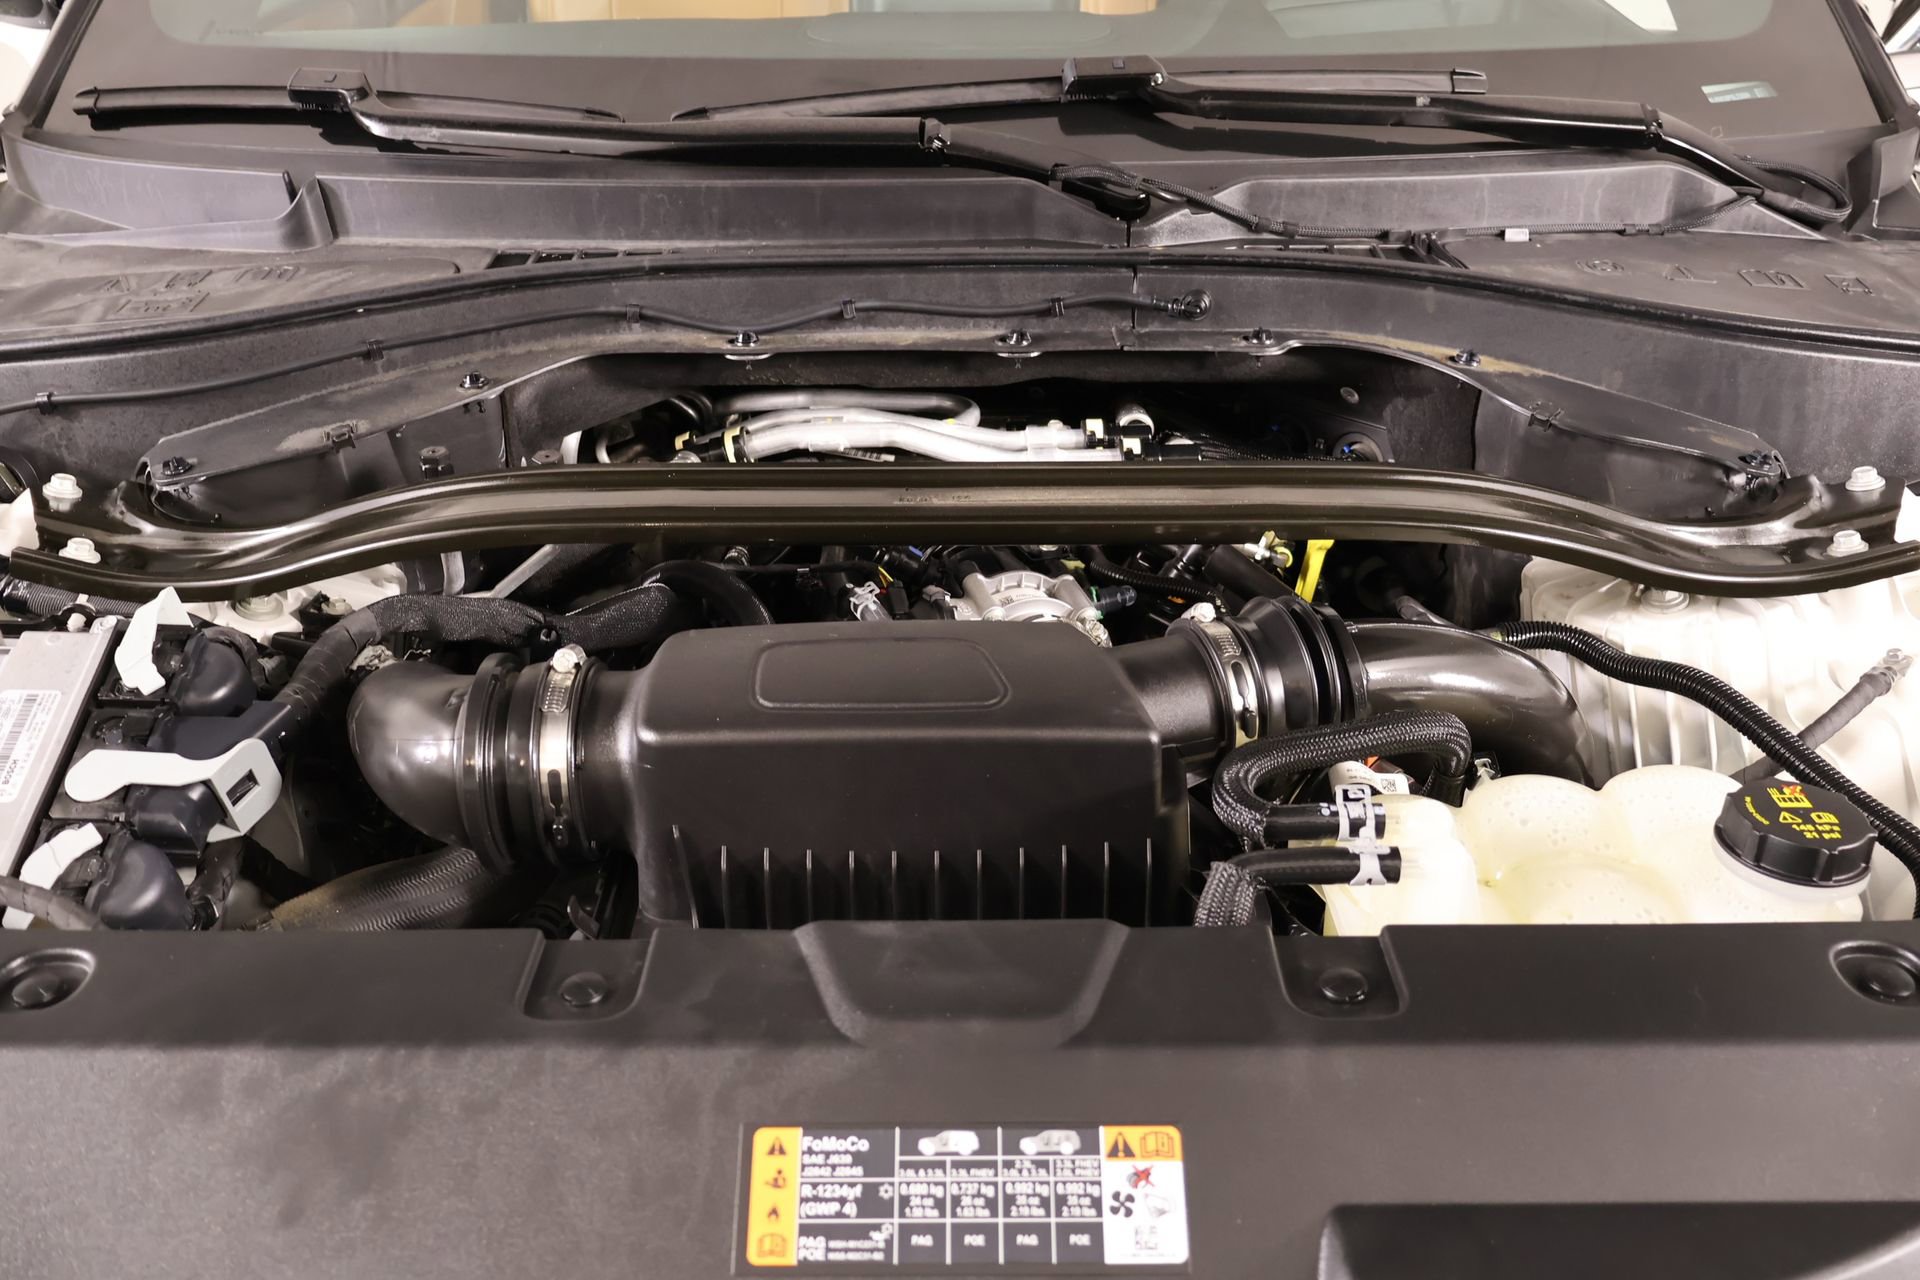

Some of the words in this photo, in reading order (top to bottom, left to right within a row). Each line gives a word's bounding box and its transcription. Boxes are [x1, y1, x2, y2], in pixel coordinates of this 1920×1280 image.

[802, 1136, 870, 1152] FoMoCo
[802, 1154, 826, 1165] SAE
[801, 1184, 863, 1201] R-1234yf
[929, 1183, 944, 1198] kg
[980, 1183, 995, 1198] kg
[1034, 1182, 1049, 1197] kg
[1085, 1182, 1101, 1197] kg
[800, 1201, 841, 1218] (GWP
[841, 1201, 858, 1218] 4)
[799, 1236, 826, 1248] PAG
[911, 1234, 933, 1246] PAG
[964, 1234, 986, 1246] POE
[1016, 1234, 1038, 1246] PAG
[1069, 1234, 1091, 1246] POE
[799, 1248, 826, 1260] POE
